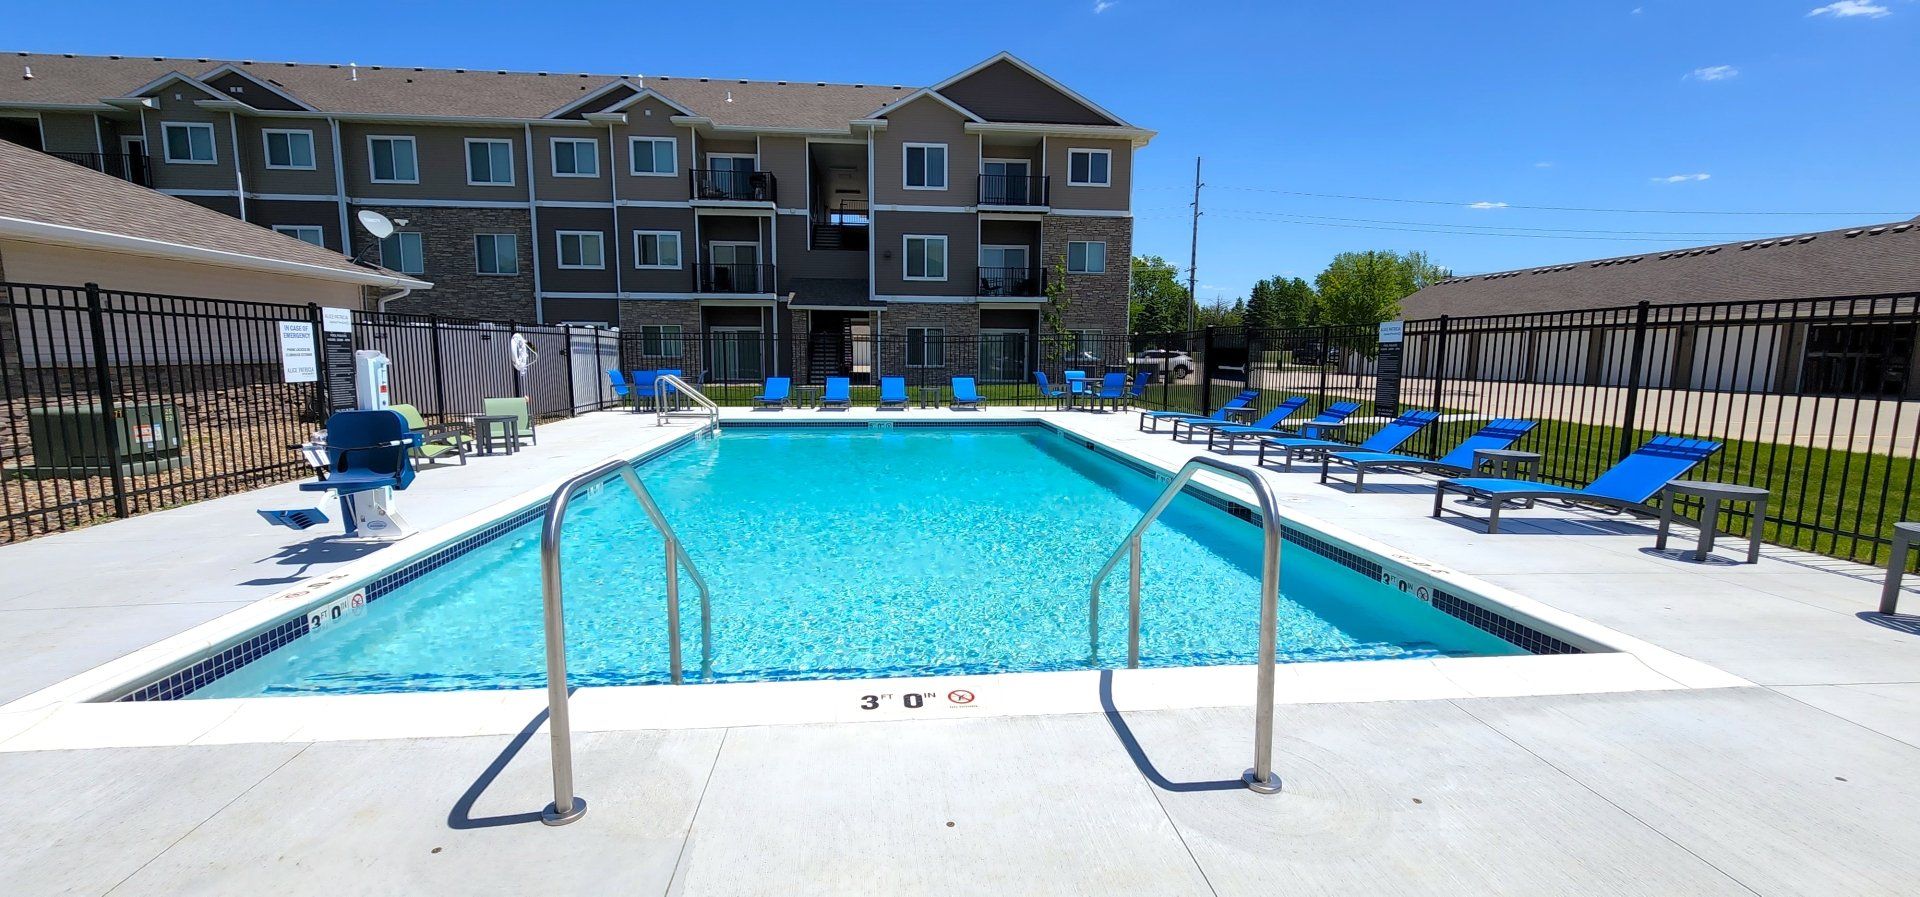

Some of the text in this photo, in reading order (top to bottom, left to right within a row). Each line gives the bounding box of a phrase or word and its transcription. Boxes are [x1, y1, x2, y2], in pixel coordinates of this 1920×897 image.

[1383, 573, 1390, 585] 3
[311, 615, 321, 629] 3
[321, 610, 328, 618] FT
[331, 605, 341, 620] 0
[861, 695, 879, 710] 3
[903, 693, 923, 709] 0
